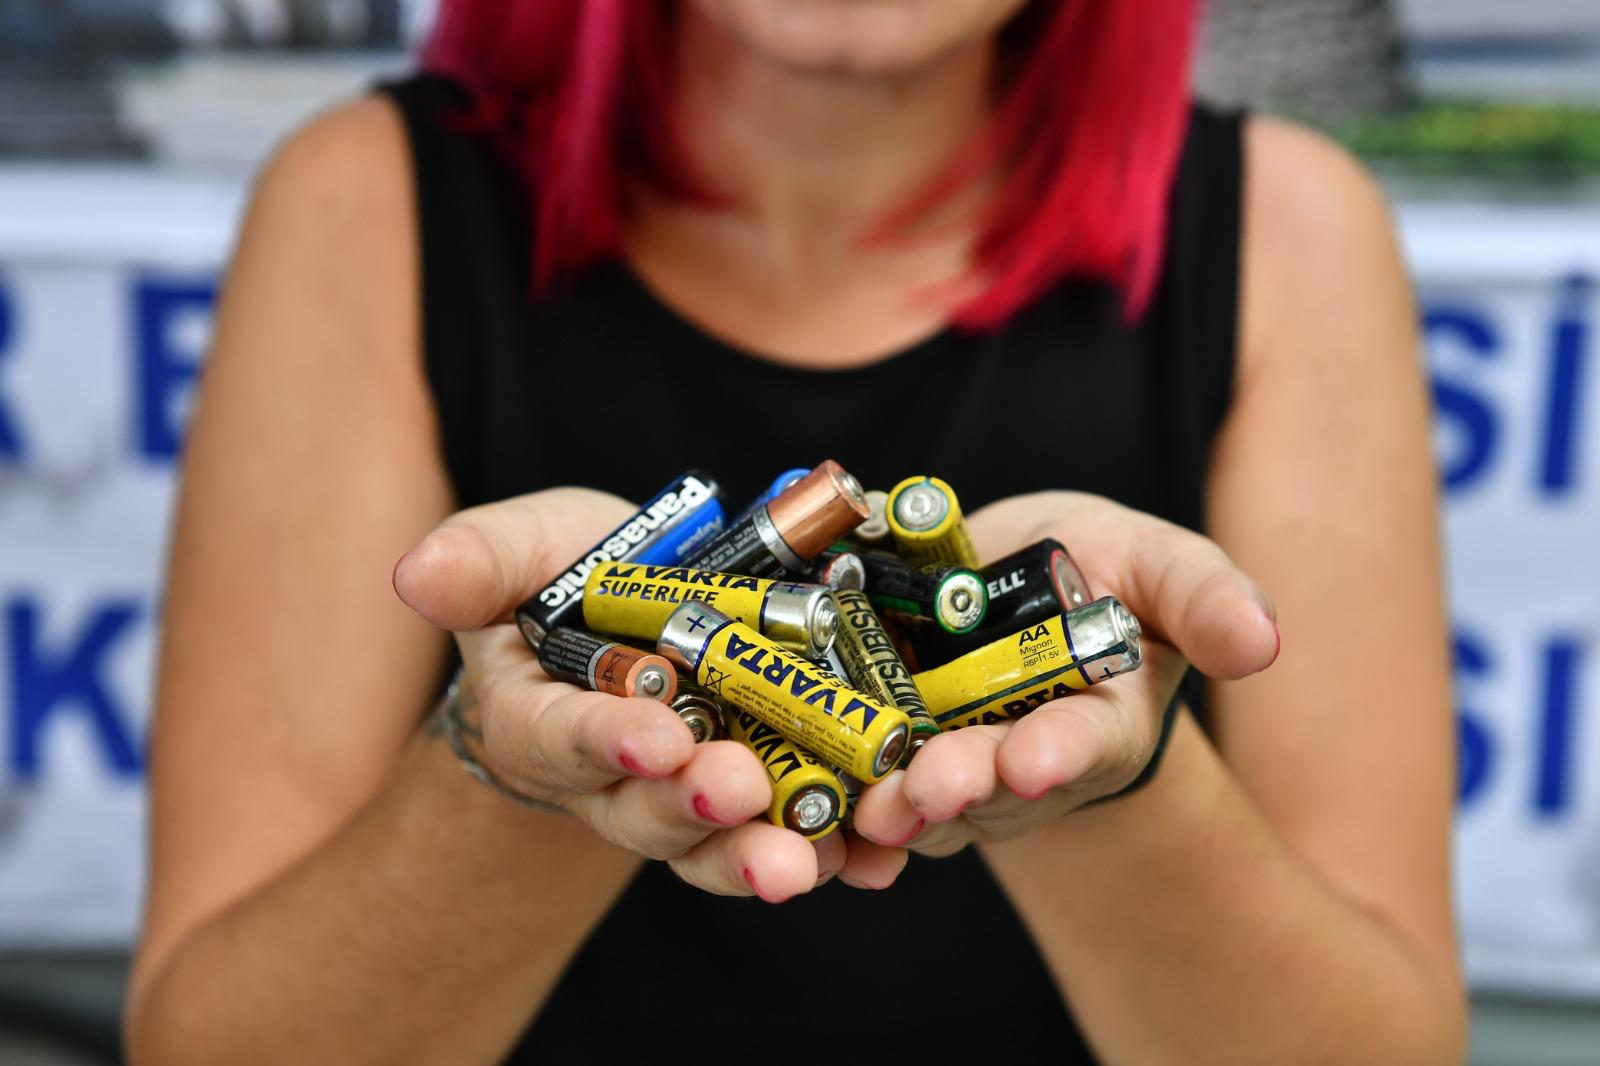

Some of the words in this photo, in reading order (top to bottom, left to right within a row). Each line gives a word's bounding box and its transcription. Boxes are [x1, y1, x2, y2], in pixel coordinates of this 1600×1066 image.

[539, 476, 713, 607] Panasonic
[598, 579, 719, 607] SUPERLIFE
[838, 593, 934, 720] MITSUBISHI
[1018, 623, 1050, 647] AA
[1019, 638, 1053, 656] Mignon
[726, 632, 838, 717] VARTA
